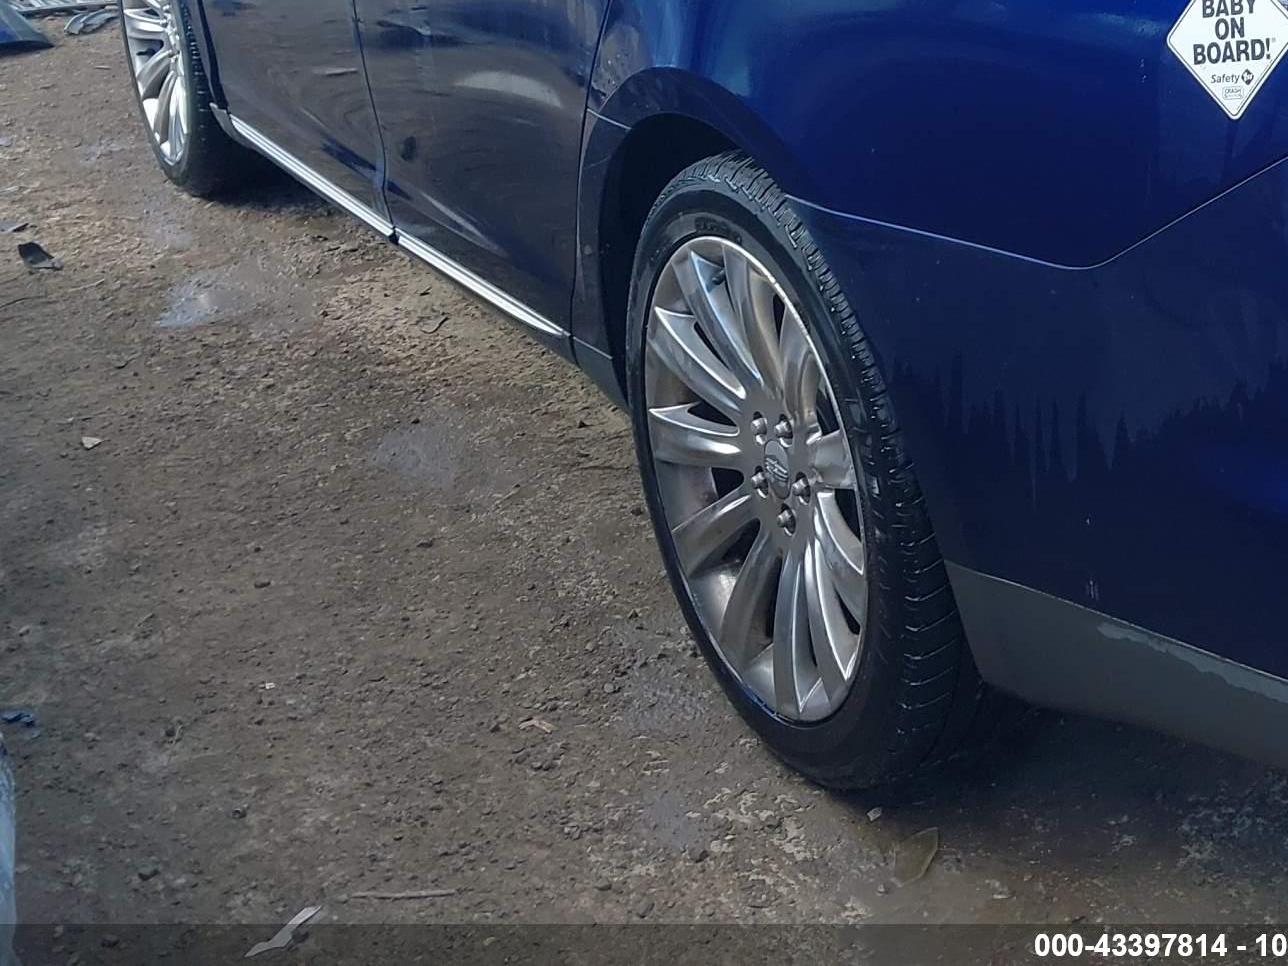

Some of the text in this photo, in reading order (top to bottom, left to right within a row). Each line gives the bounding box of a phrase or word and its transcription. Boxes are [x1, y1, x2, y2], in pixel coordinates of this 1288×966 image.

[1214, 17, 1245, 40] ON
[1193, 38, 1271, 65] BOARD!
[1211, 73, 1240, 84] Safety
